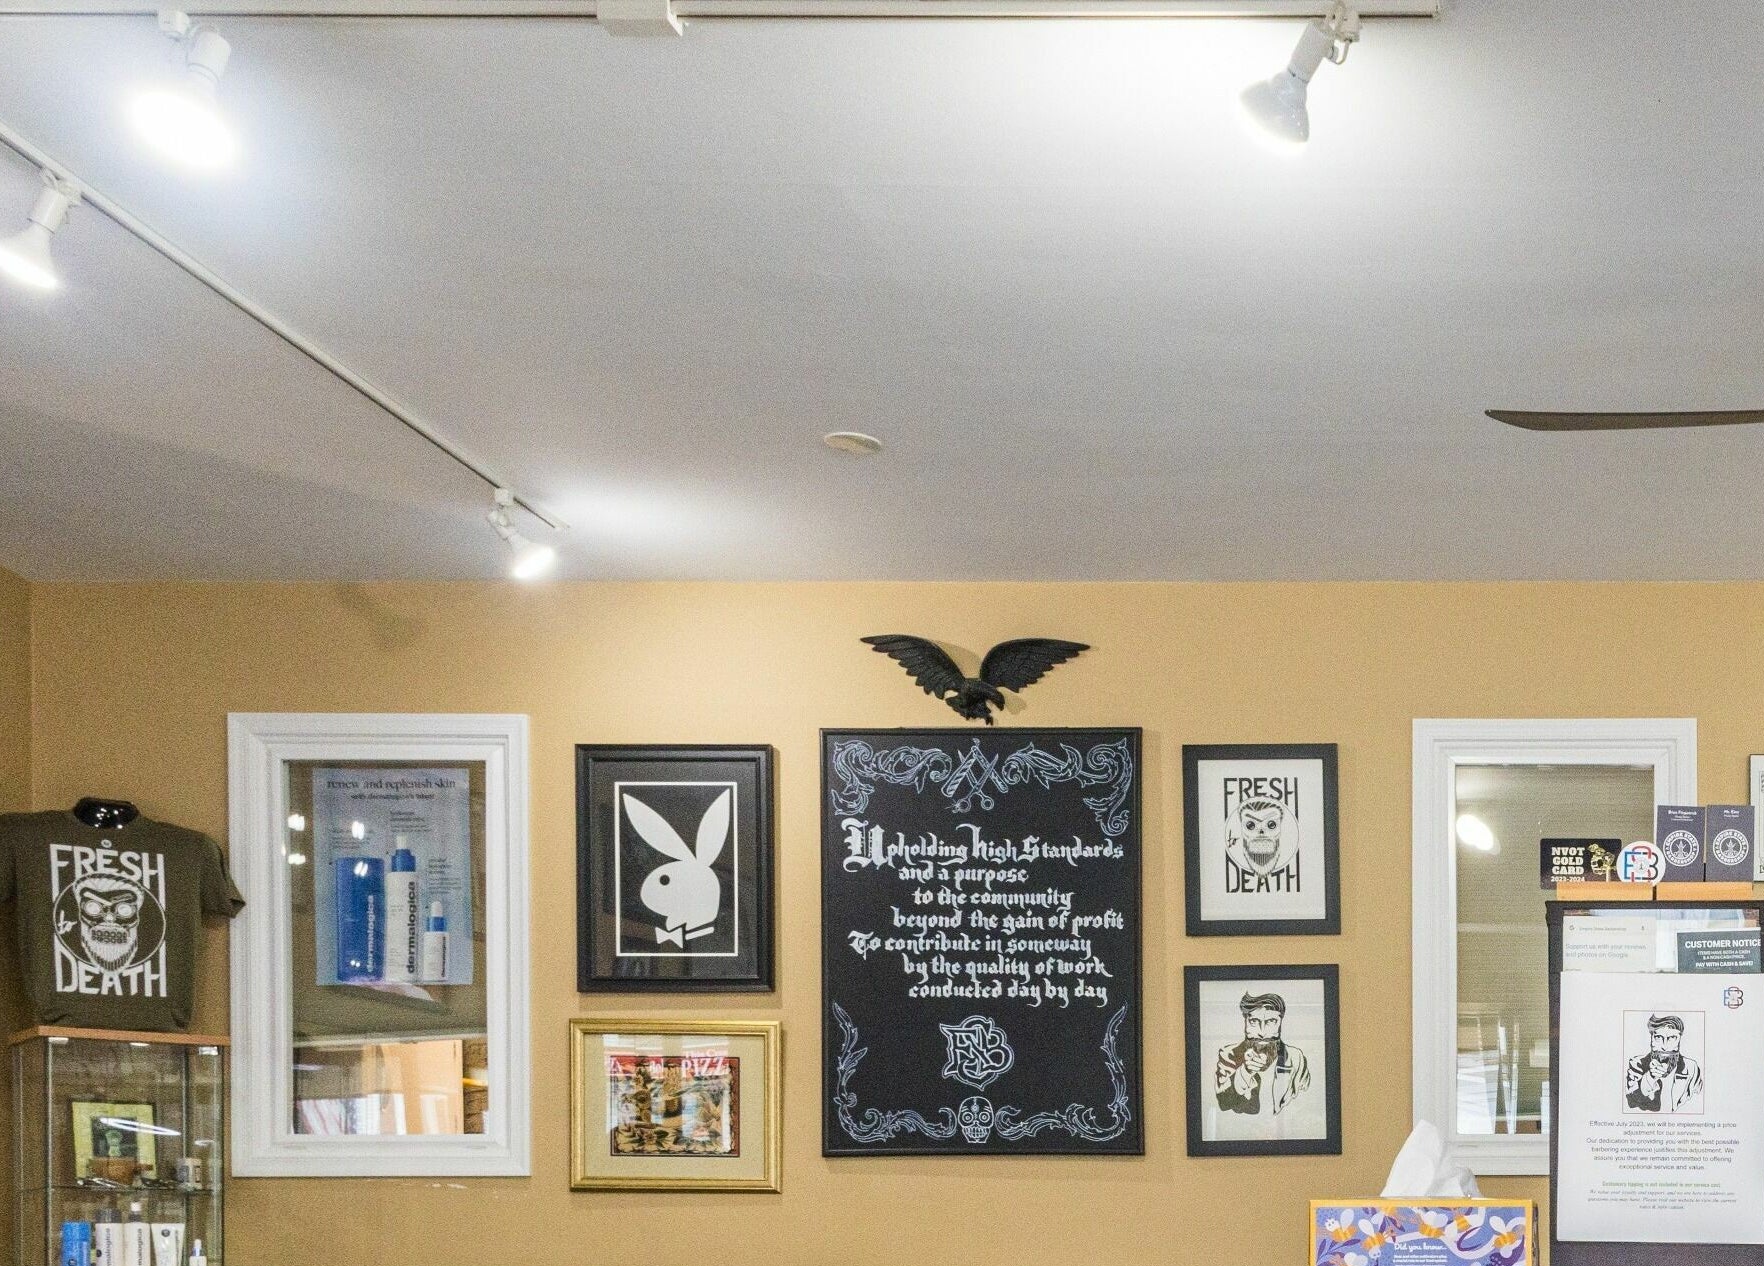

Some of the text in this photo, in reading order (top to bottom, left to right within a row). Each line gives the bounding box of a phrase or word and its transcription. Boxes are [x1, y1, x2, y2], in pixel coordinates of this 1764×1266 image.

[363, 779, 383, 789] and
[434, 778, 456, 789] skin
[1223, 777, 1299, 817] FRESH
[841, 817, 968, 873] Upholding
[1017, 835, 1124, 867] Standards
[1551, 846, 1586, 856] NVOT
[899, 860, 1029, 890] and a purpose
[1225, 848, 1300, 893] DEATH
[1552, 856, 1586, 866] GOLD
[1552, 866, 1585, 875] CARD
[49, 844, 166, 911] FRESH
[912, 885, 1075, 912] to the community
[367, 895, 376, 973] dermalogica
[406, 881, 418, 974] dermalogica
[890, 906, 1124, 937] beyond the gain of profit
[848, 930, 881, 961] To
[885, 930, 982, 954] contribute
[986, 935, 1003, 954] in
[1685, 938, 1761, 949] CUSTOMER NOTICE
[53, 931, 168, 998] DEATH
[902, 952, 1113, 985] by the quality of work
[908, 978, 1108, 1008] conducted day by day
[1616, 1121, 1628, 1129] July
